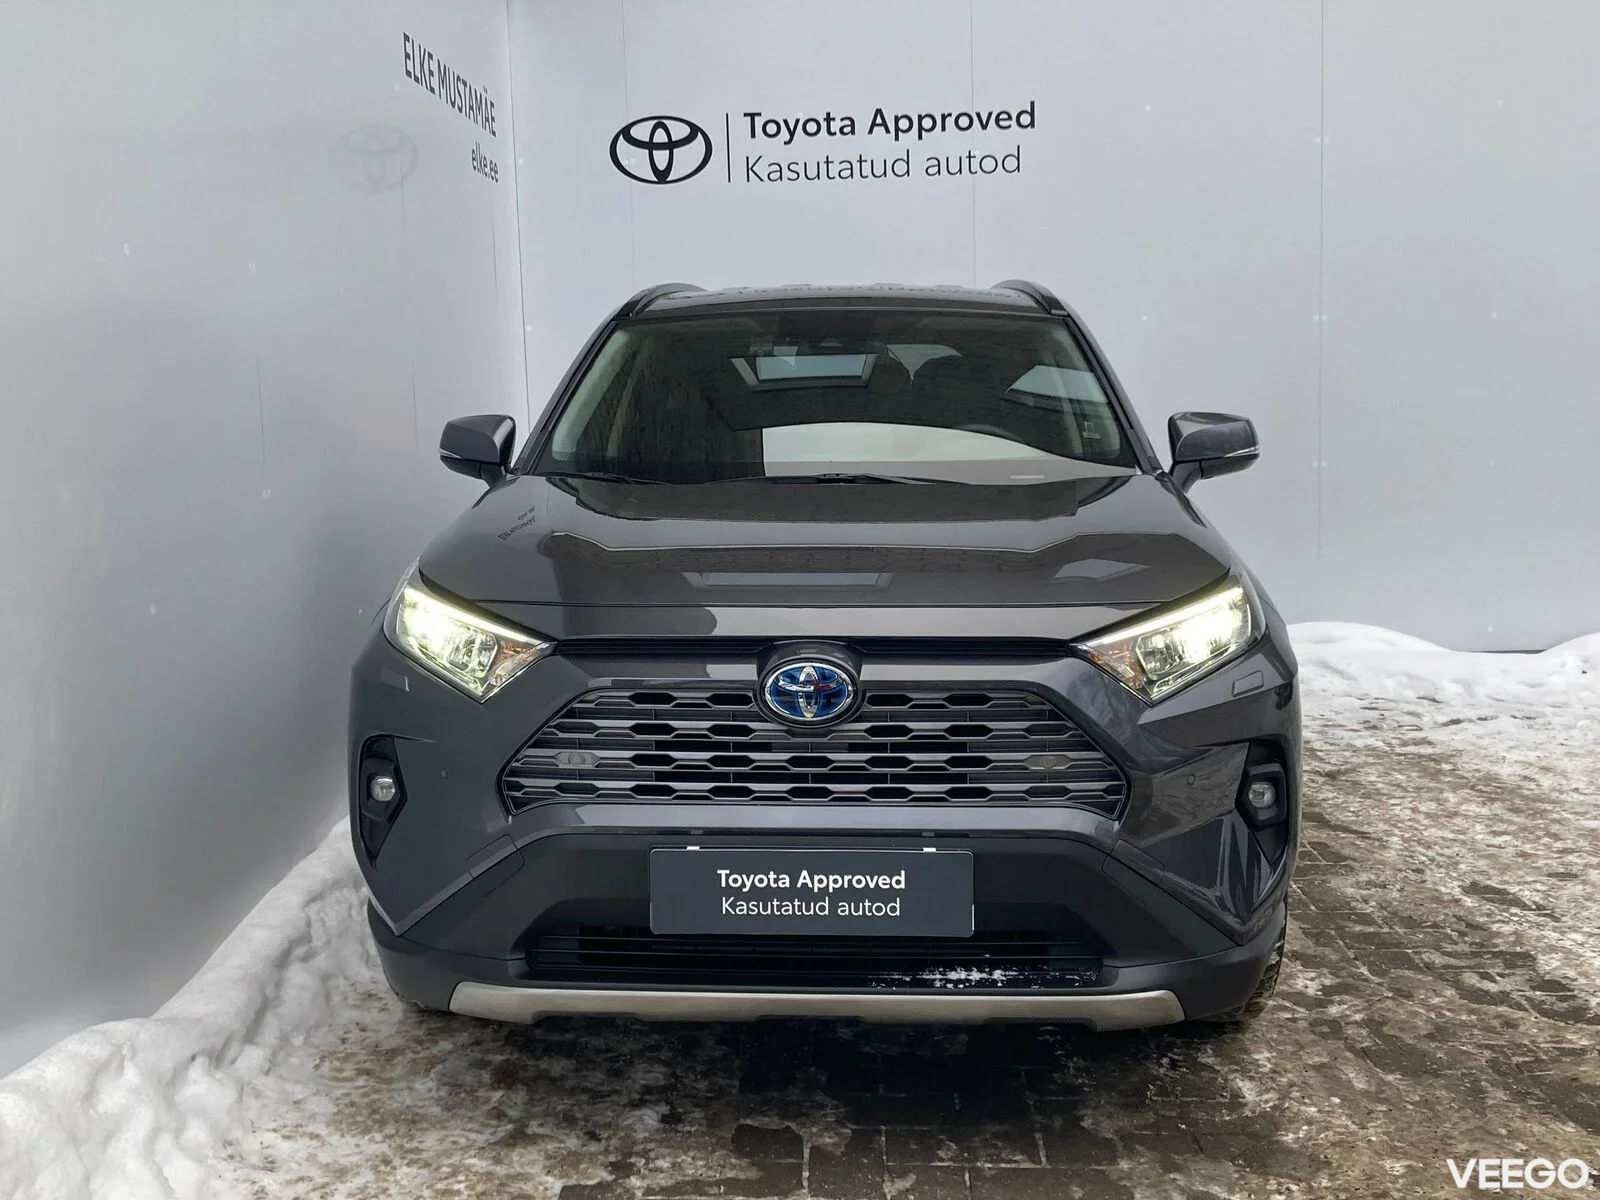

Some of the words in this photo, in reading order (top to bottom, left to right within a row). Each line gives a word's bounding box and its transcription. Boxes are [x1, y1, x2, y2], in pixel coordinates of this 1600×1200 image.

[403, 32, 436, 95] ELKE
[437, 58, 497, 138] MUSTAMÄE
[743, 111, 857, 146] Toyota
[867, 100, 1037, 141] Approved
[471, 141, 499, 183] elke.ee
[745, 149, 911, 184] Kasutatud
[925, 145, 1021, 178] autod
[717, 869, 791, 893] Toyota
[796, 869, 907, 893] Approved
[721, 896, 830, 916] Kasutatud
[837, 896, 901, 917] autod
